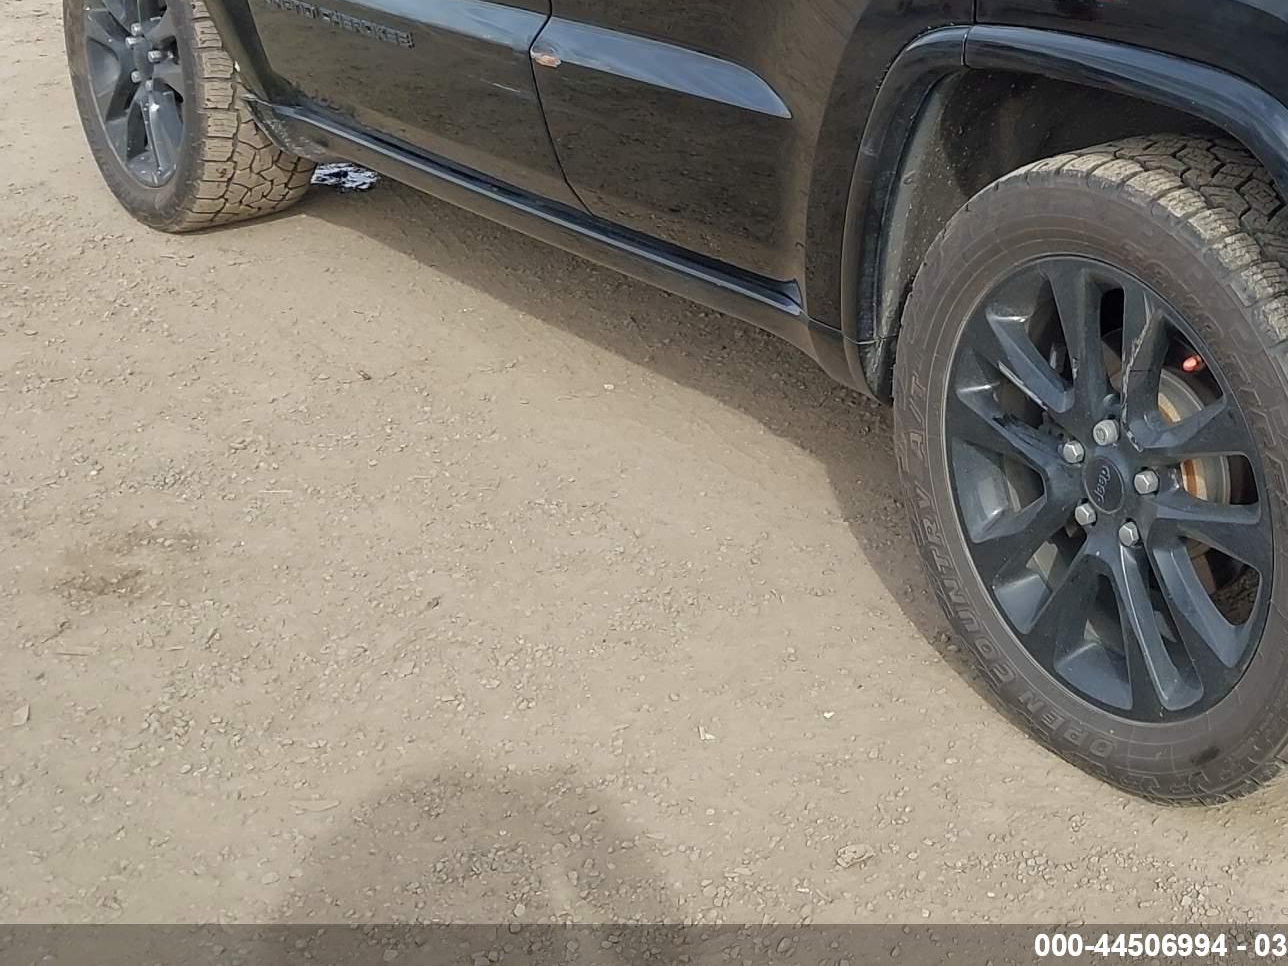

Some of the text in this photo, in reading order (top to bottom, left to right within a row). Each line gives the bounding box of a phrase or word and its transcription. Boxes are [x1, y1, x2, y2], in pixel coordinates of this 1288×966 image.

[318, 7, 416, 49] CHEROKEE
[1094, 465, 1111, 505] Jeep
[913, 480, 1016, 690] COUNTRY
[1018, 685, 1111, 762] OPEN
